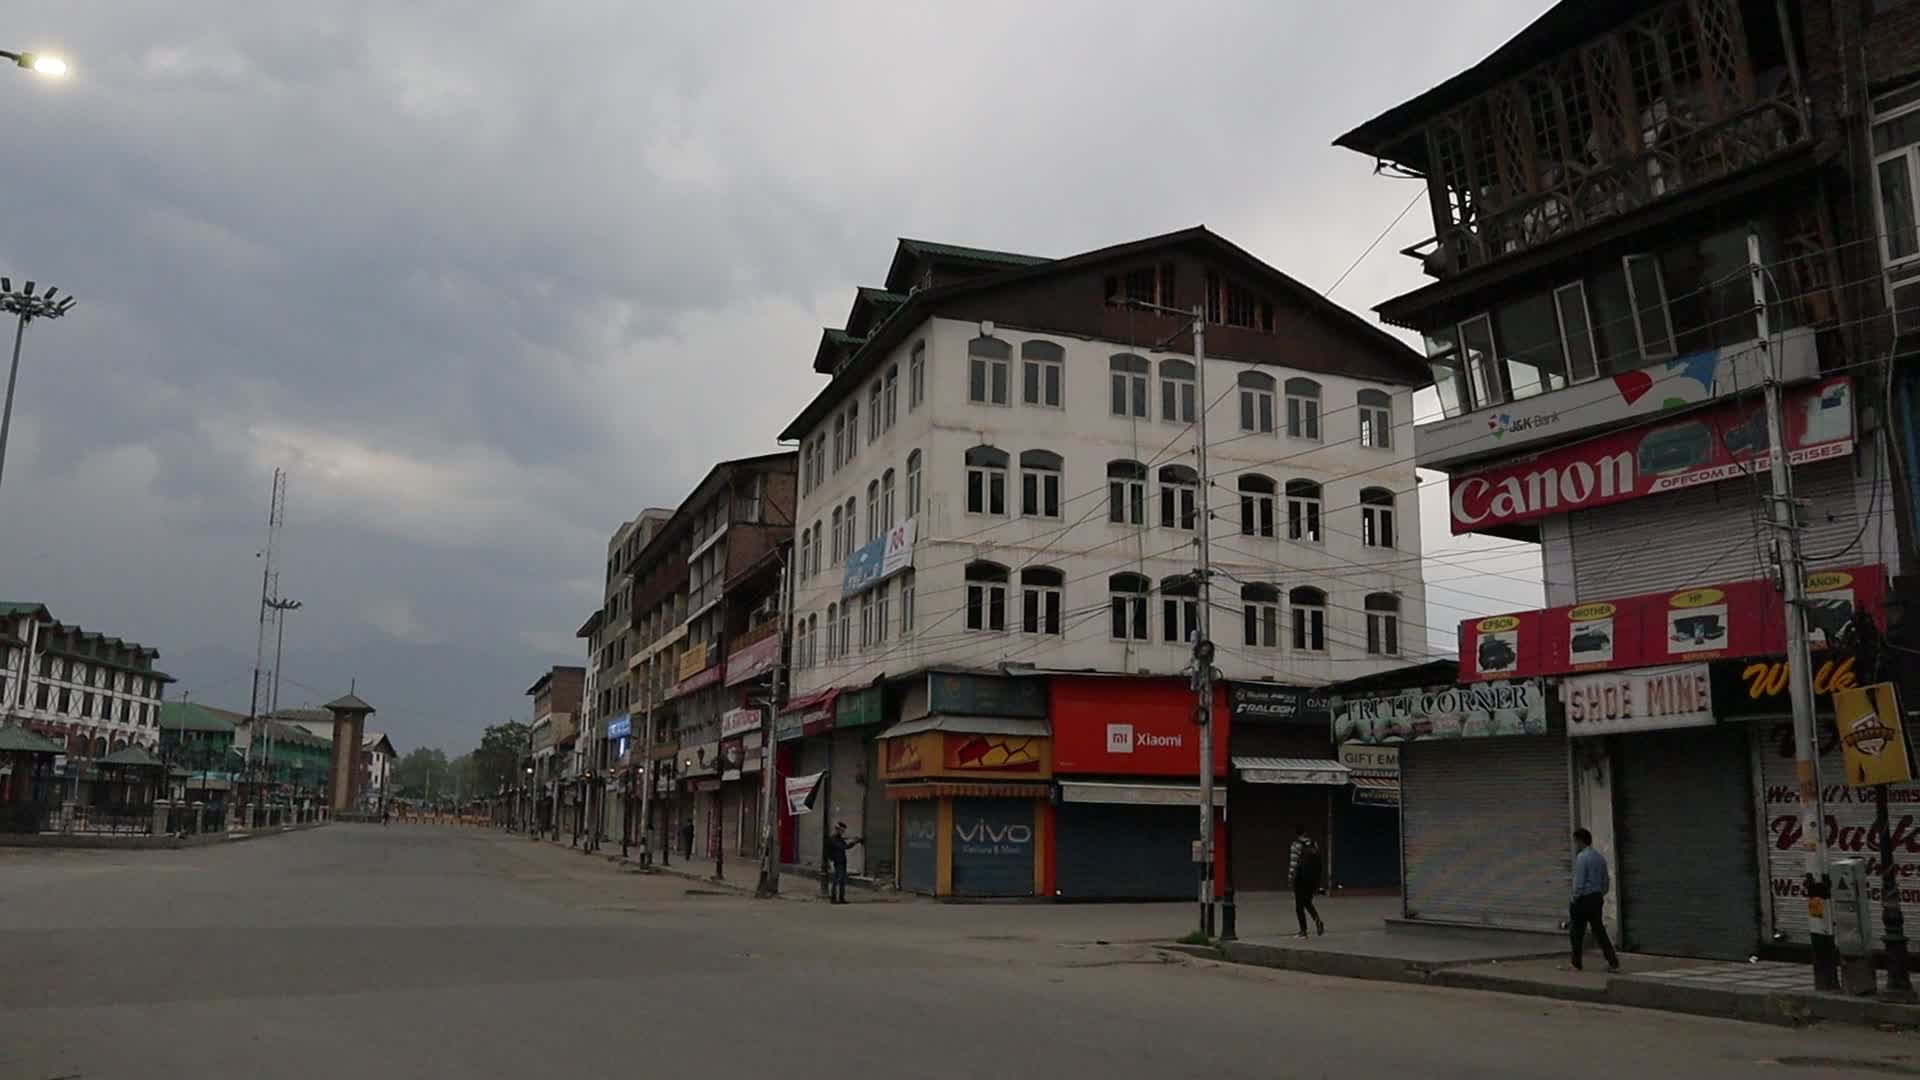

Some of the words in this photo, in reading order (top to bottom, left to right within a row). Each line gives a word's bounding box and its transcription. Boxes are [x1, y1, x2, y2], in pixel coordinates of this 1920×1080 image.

[1451, 449, 1634, 525] Canon
[1808, 575, 1841, 588] ANON
[1482, 618, 1514, 630] EPSON
[1742, 655, 1860, 699] Wlk
[1420, 685, 1530, 715] CORNER
[1572, 680, 1633, 722] SHOE
[1136, 731, 1183, 747] Xiaomi
[1344, 752, 1374, 765] GIFT
[955, 816, 1032, 843] vivo
